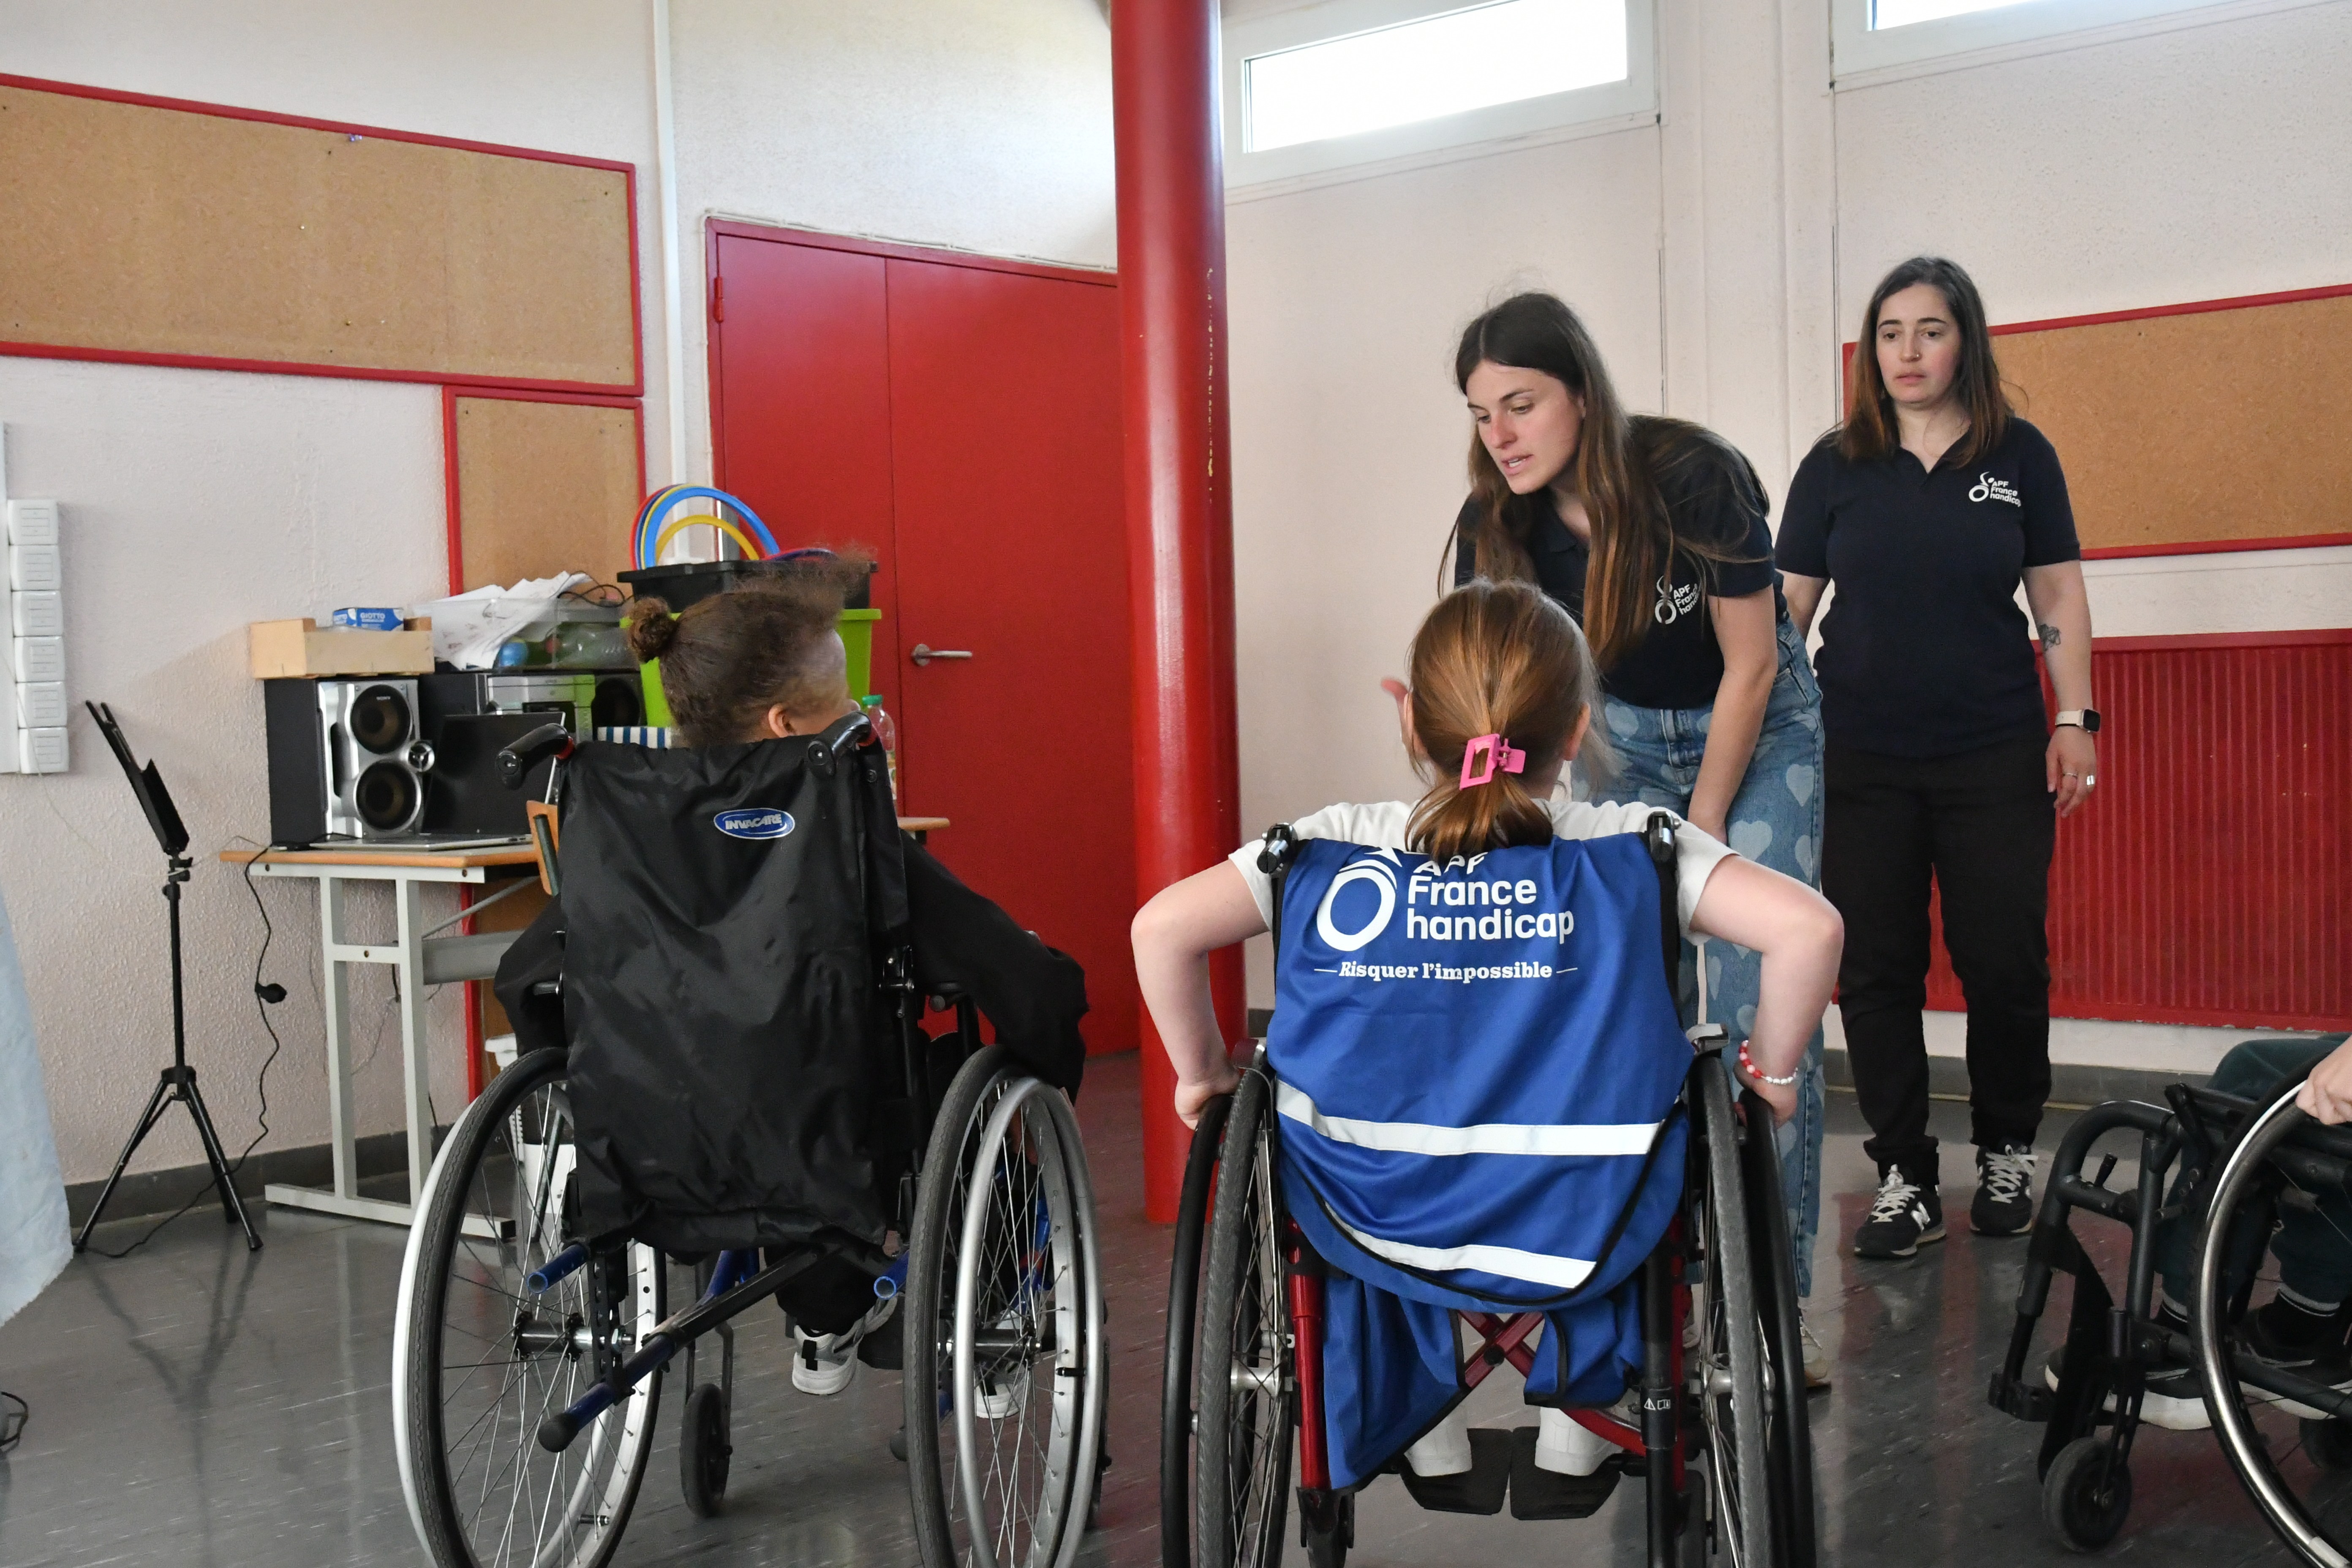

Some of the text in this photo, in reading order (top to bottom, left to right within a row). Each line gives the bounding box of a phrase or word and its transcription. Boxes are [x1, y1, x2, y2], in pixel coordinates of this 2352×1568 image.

[1991, 487, 2018, 496] France
[1673, 584, 1690, 599] APF
[725, 814, 781, 830] INVACARE
[1413, 852, 1488, 876] APF
[1407, 875, 1537, 906] France
[1407, 908, 1574, 944] handicap
[1339, 961, 1552, 983] Risquer l'impossible
